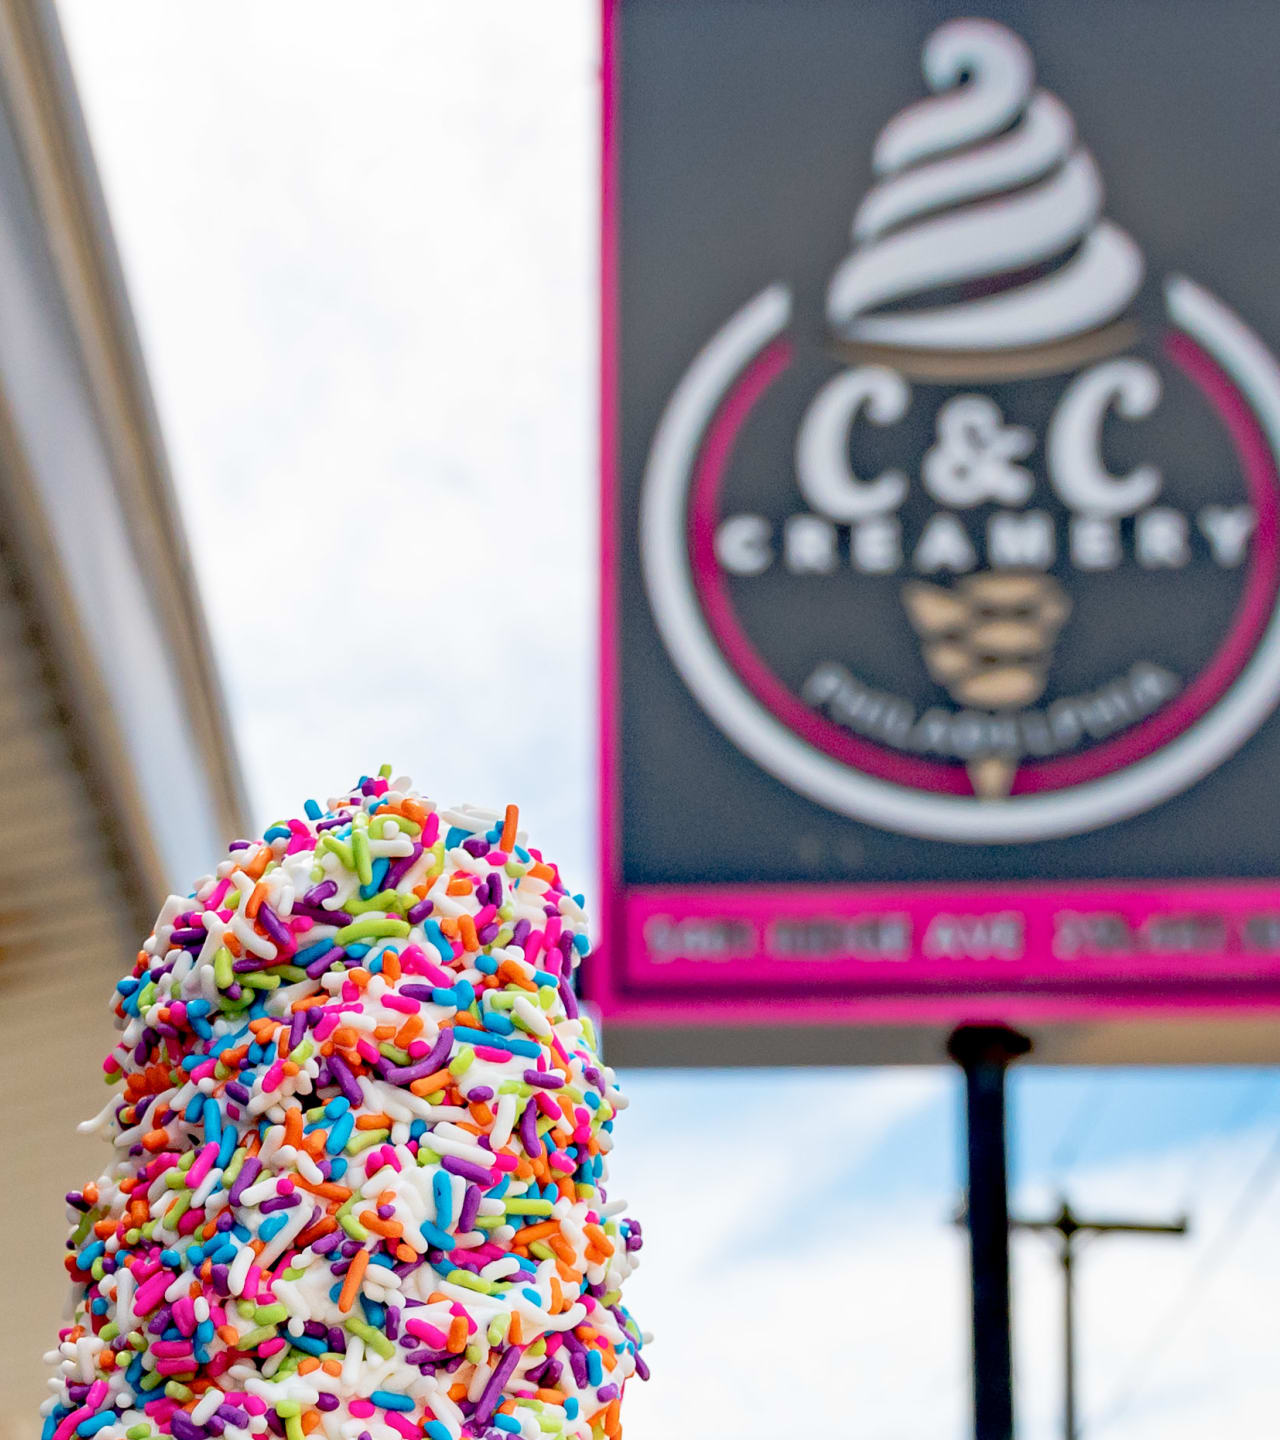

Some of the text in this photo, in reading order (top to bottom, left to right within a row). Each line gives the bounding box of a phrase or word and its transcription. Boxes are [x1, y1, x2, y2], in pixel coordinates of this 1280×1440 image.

[716, 505, 1254, 574] CREAMERY
[804, 663, 1180, 754] PHILADELPHIA
[925, 911, 1024, 960] AVE
